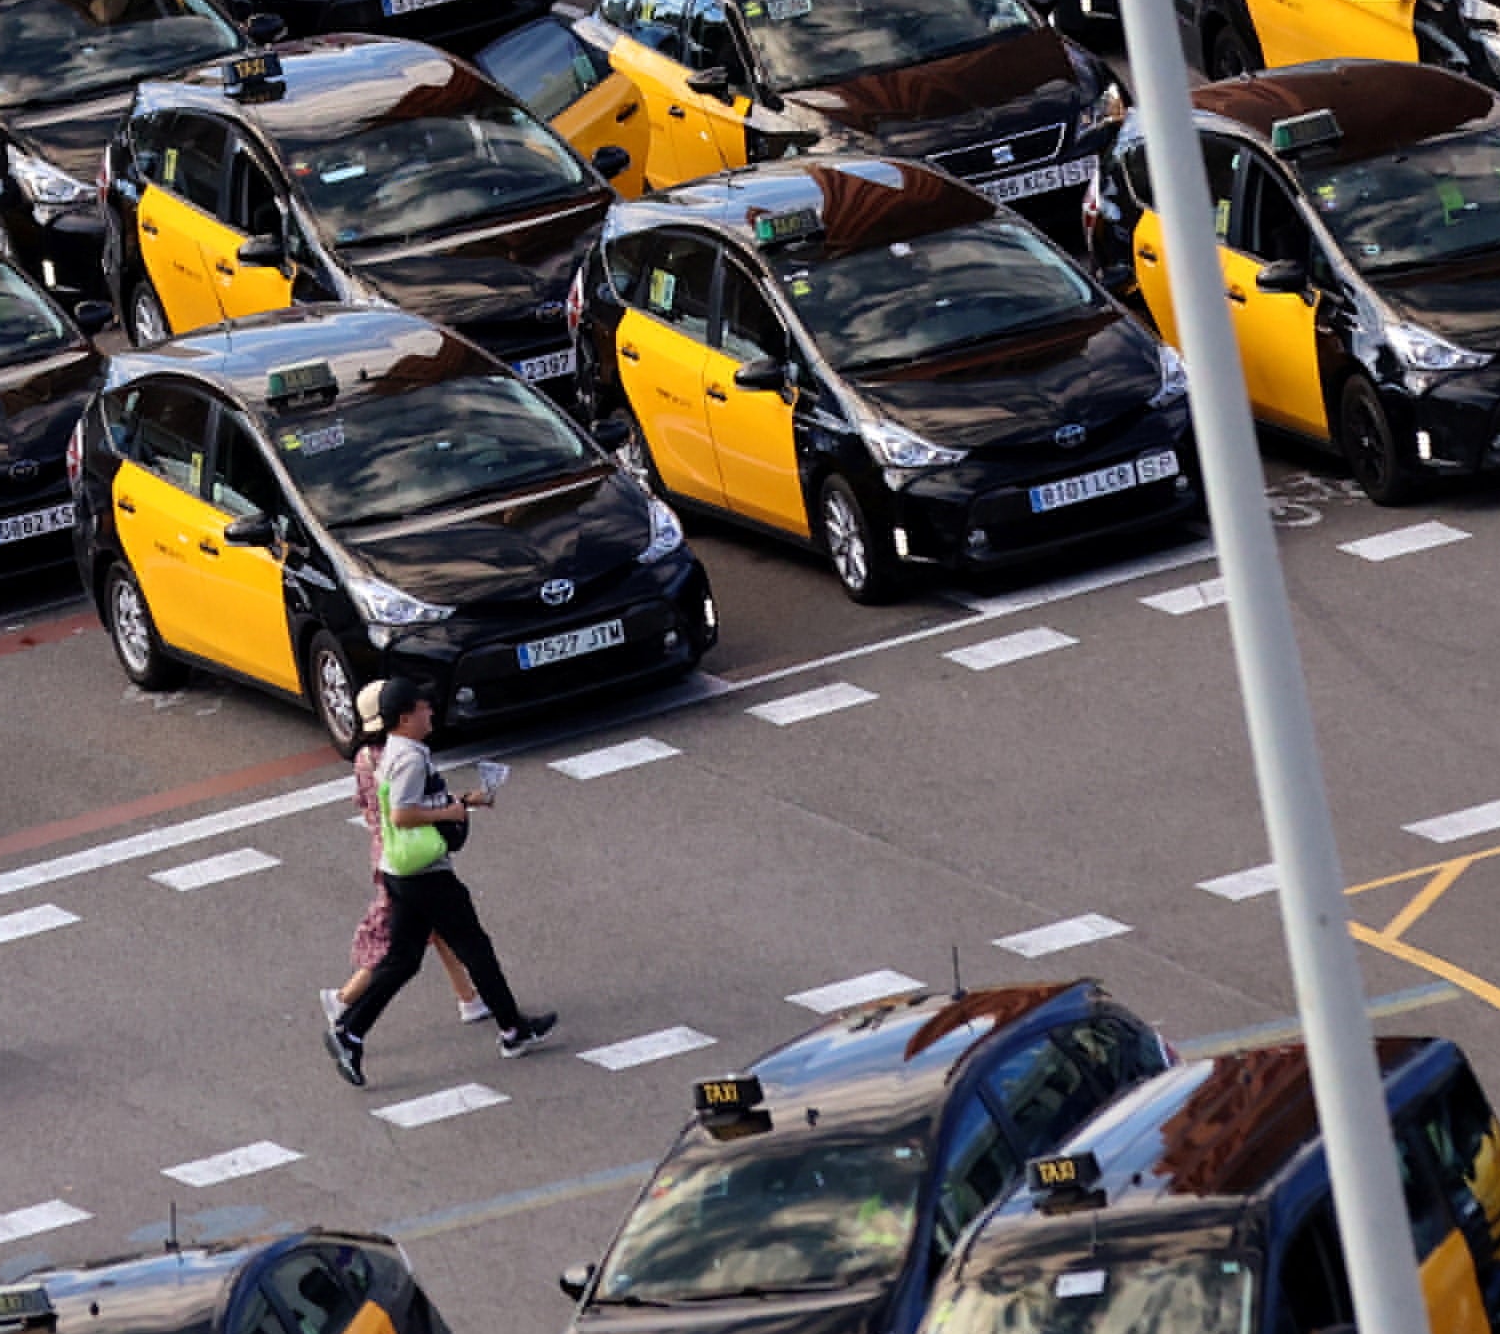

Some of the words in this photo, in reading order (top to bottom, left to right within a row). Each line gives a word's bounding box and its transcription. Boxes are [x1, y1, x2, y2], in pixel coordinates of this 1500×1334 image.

[235, 58, 265, 76] TAXI
[524, 350, 570, 379] 2397
[1140, 453, 1175, 477] SP
[532, 633, 579, 661] 7527
[703, 1082, 738, 1103] TAXI
[1039, 1161, 1075, 1182] TAXI
